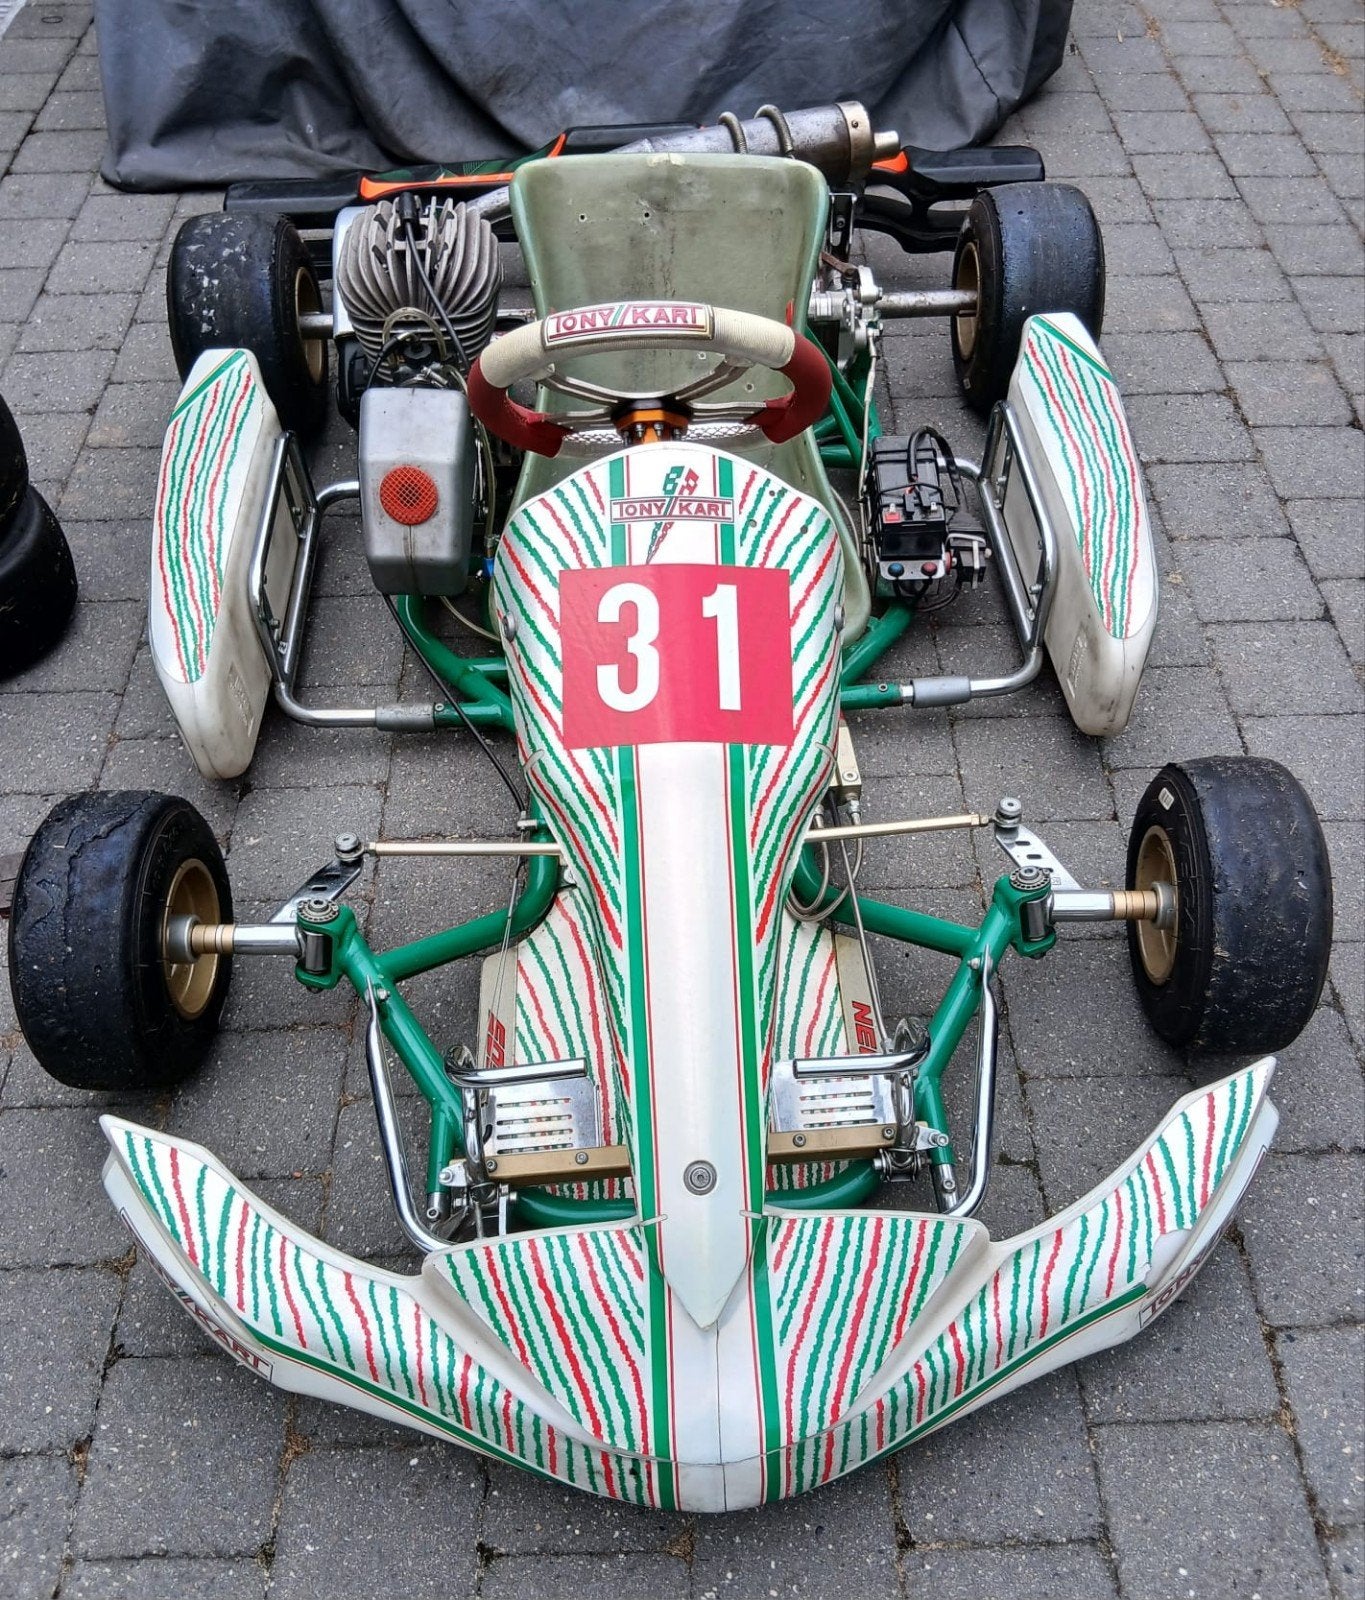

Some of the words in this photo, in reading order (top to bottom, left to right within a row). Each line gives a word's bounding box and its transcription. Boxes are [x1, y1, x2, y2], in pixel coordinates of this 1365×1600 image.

[551, 308, 614, 333] TONY
[631, 306, 702, 325] KART
[613, 499, 665, 518] TONY
[678, 500, 731, 518] KART
[852, 1001, 877, 1054] NE
